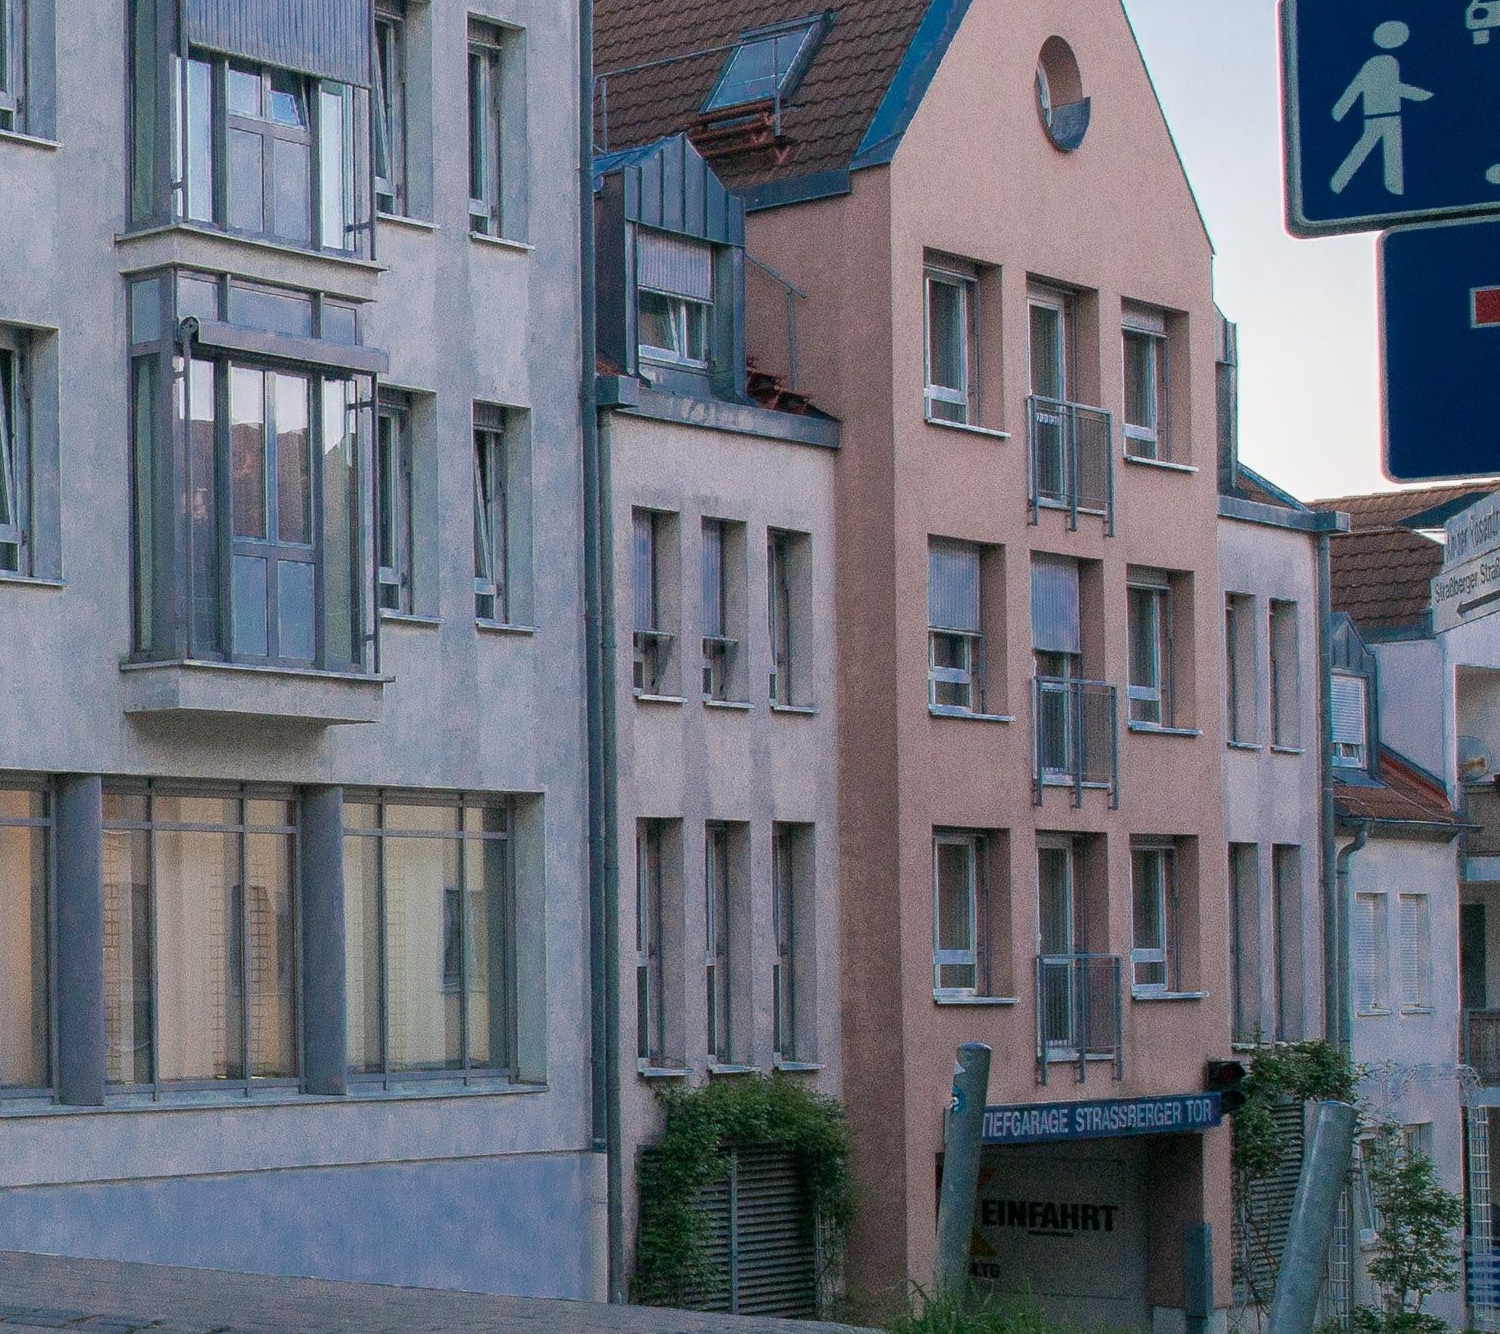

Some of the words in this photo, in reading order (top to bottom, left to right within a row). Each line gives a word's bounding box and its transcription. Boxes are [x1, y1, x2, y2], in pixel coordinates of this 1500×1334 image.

[1075, 1099, 1181, 1133] STRASSBERGER
[1185, 1098, 1212, 1123] TOR
[981, 1199, 1118, 1231] EINFAHRT
